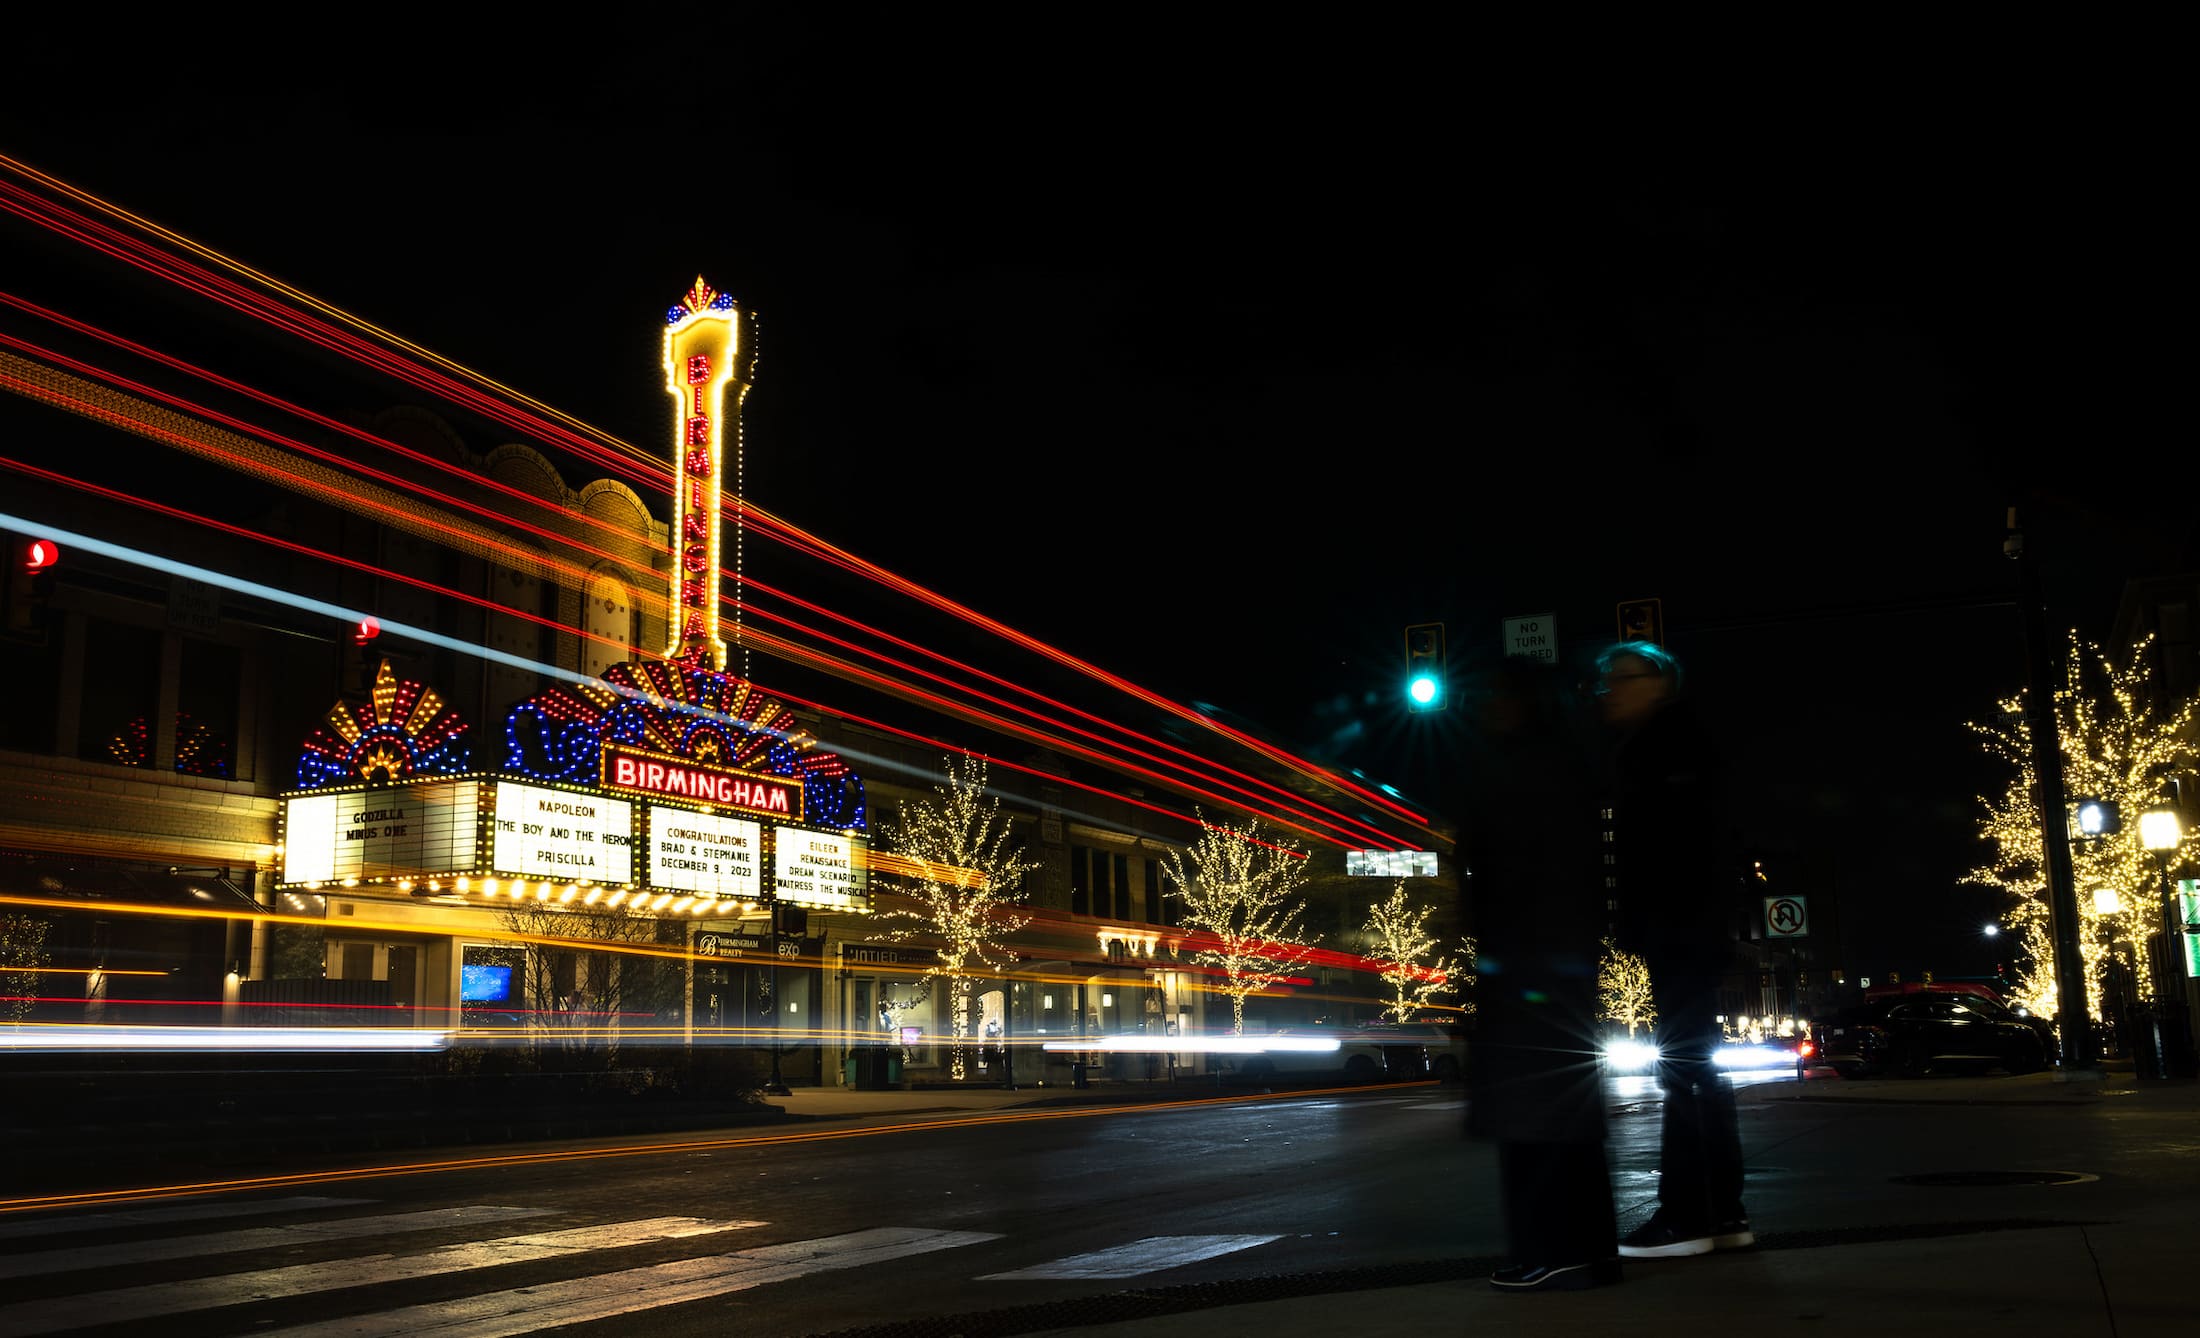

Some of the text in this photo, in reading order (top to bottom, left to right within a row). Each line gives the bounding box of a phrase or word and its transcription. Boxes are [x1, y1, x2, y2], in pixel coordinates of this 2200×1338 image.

[1520, 622, 1538, 633] NO
[1515, 635, 1546, 648] TURN
[616, 757, 789, 812] BIRMINGHAM
[353, 808, 404, 824] GODZILLA
[539, 800, 596, 818] NAPOLEON
[346, 825, 408, 841] MINUS ONE
[497, 819, 632, 847] THE BOY AND THE HERON
[667, 827, 748, 848] CONGRATULATIONS
[661, 841, 751, 863] BRAD & STEPHANIE
[809, 841, 839, 854] EILEEN
[537, 850, 595, 867] PRISCILLA
[800, 854, 848, 869] RENAISSANCE
[661, 857, 708, 873] DECEMBER
[730, 865, 752, 877] 2023
[788, 866, 857, 883] DREAM SCENARIO
[777, 878, 814, 891] WAITRESS
[820, 884, 833, 894] THE
[720, 938, 759, 949] BIRMINGHAM
